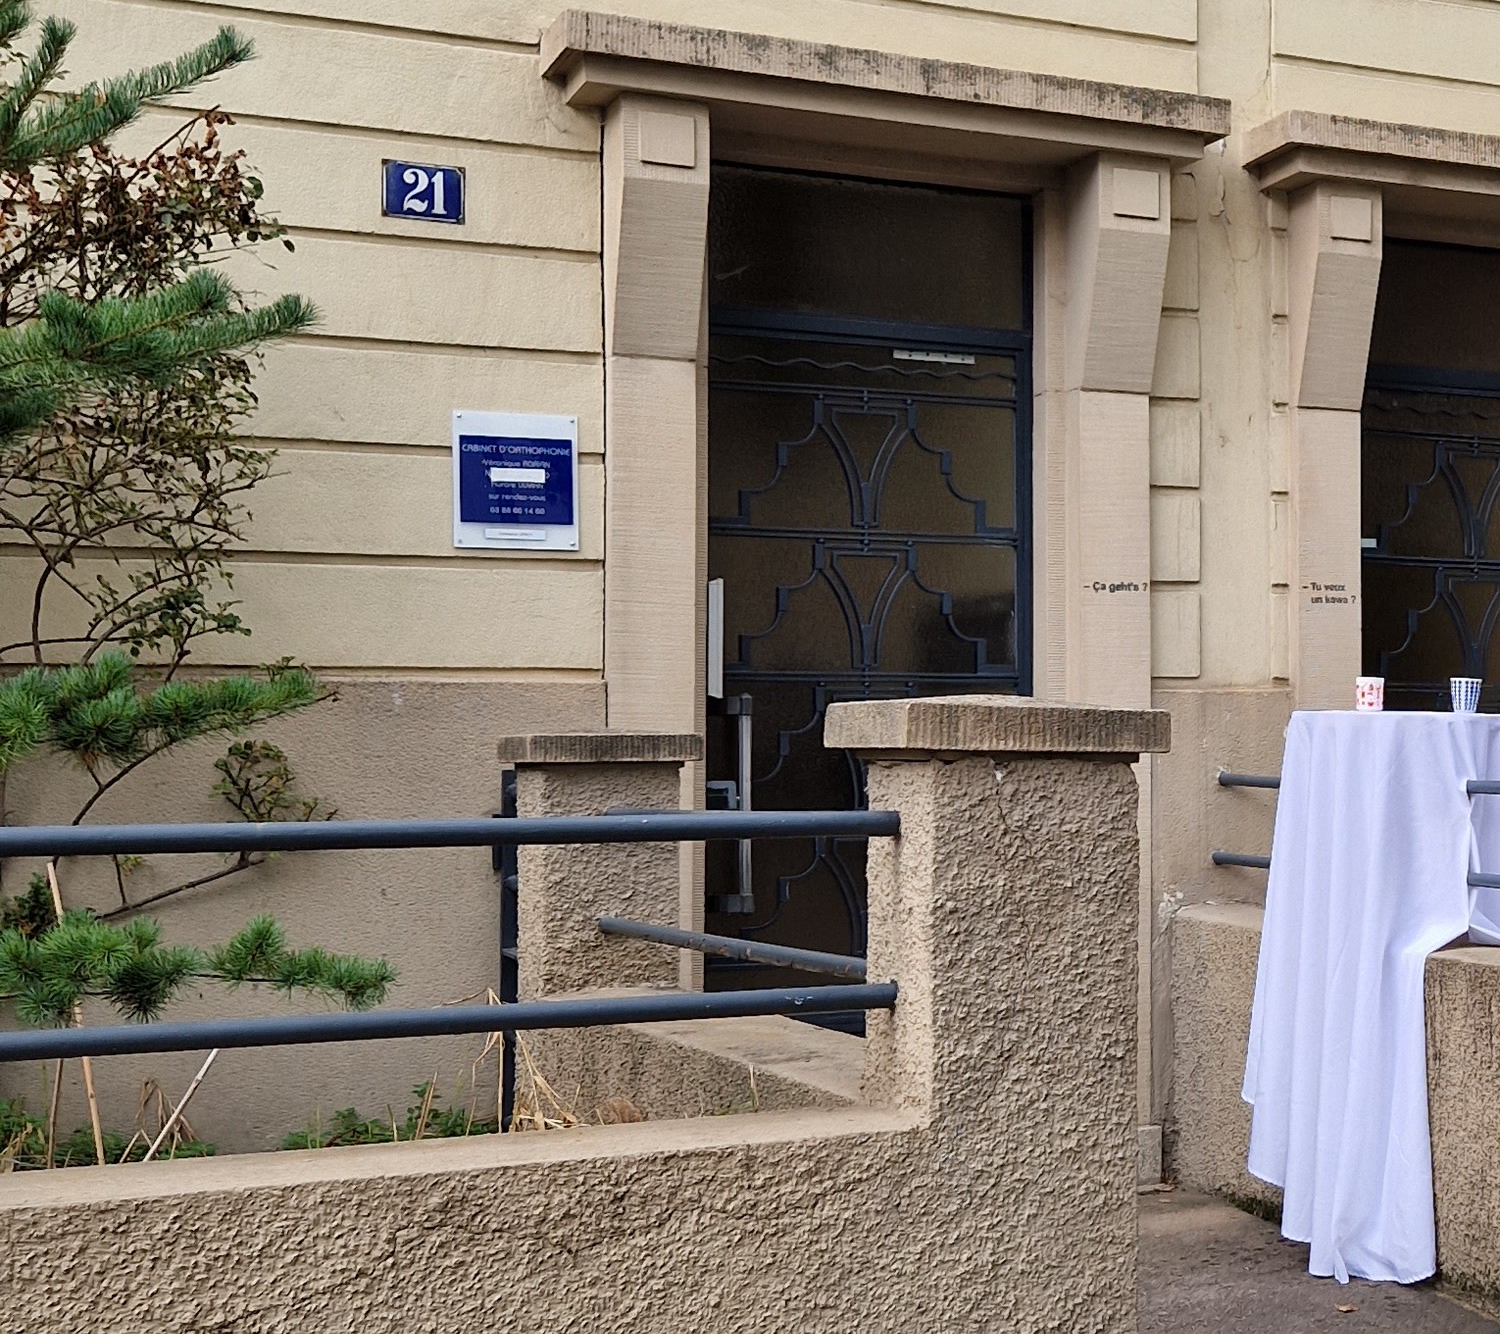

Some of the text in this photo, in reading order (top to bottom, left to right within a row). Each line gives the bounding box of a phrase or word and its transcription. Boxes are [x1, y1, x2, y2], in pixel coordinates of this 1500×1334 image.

[402, 168, 448, 215] 21
[461, 444, 571, 456] CABINET D'ORTHOPHONIE
[1092, 581, 1107, 594] Ça
[1108, 581, 1140, 593] geht's
[1310, 582, 1322, 591] Tu
[1311, 596, 1323, 604] un
[1351, 595, 1357, 604] ?
